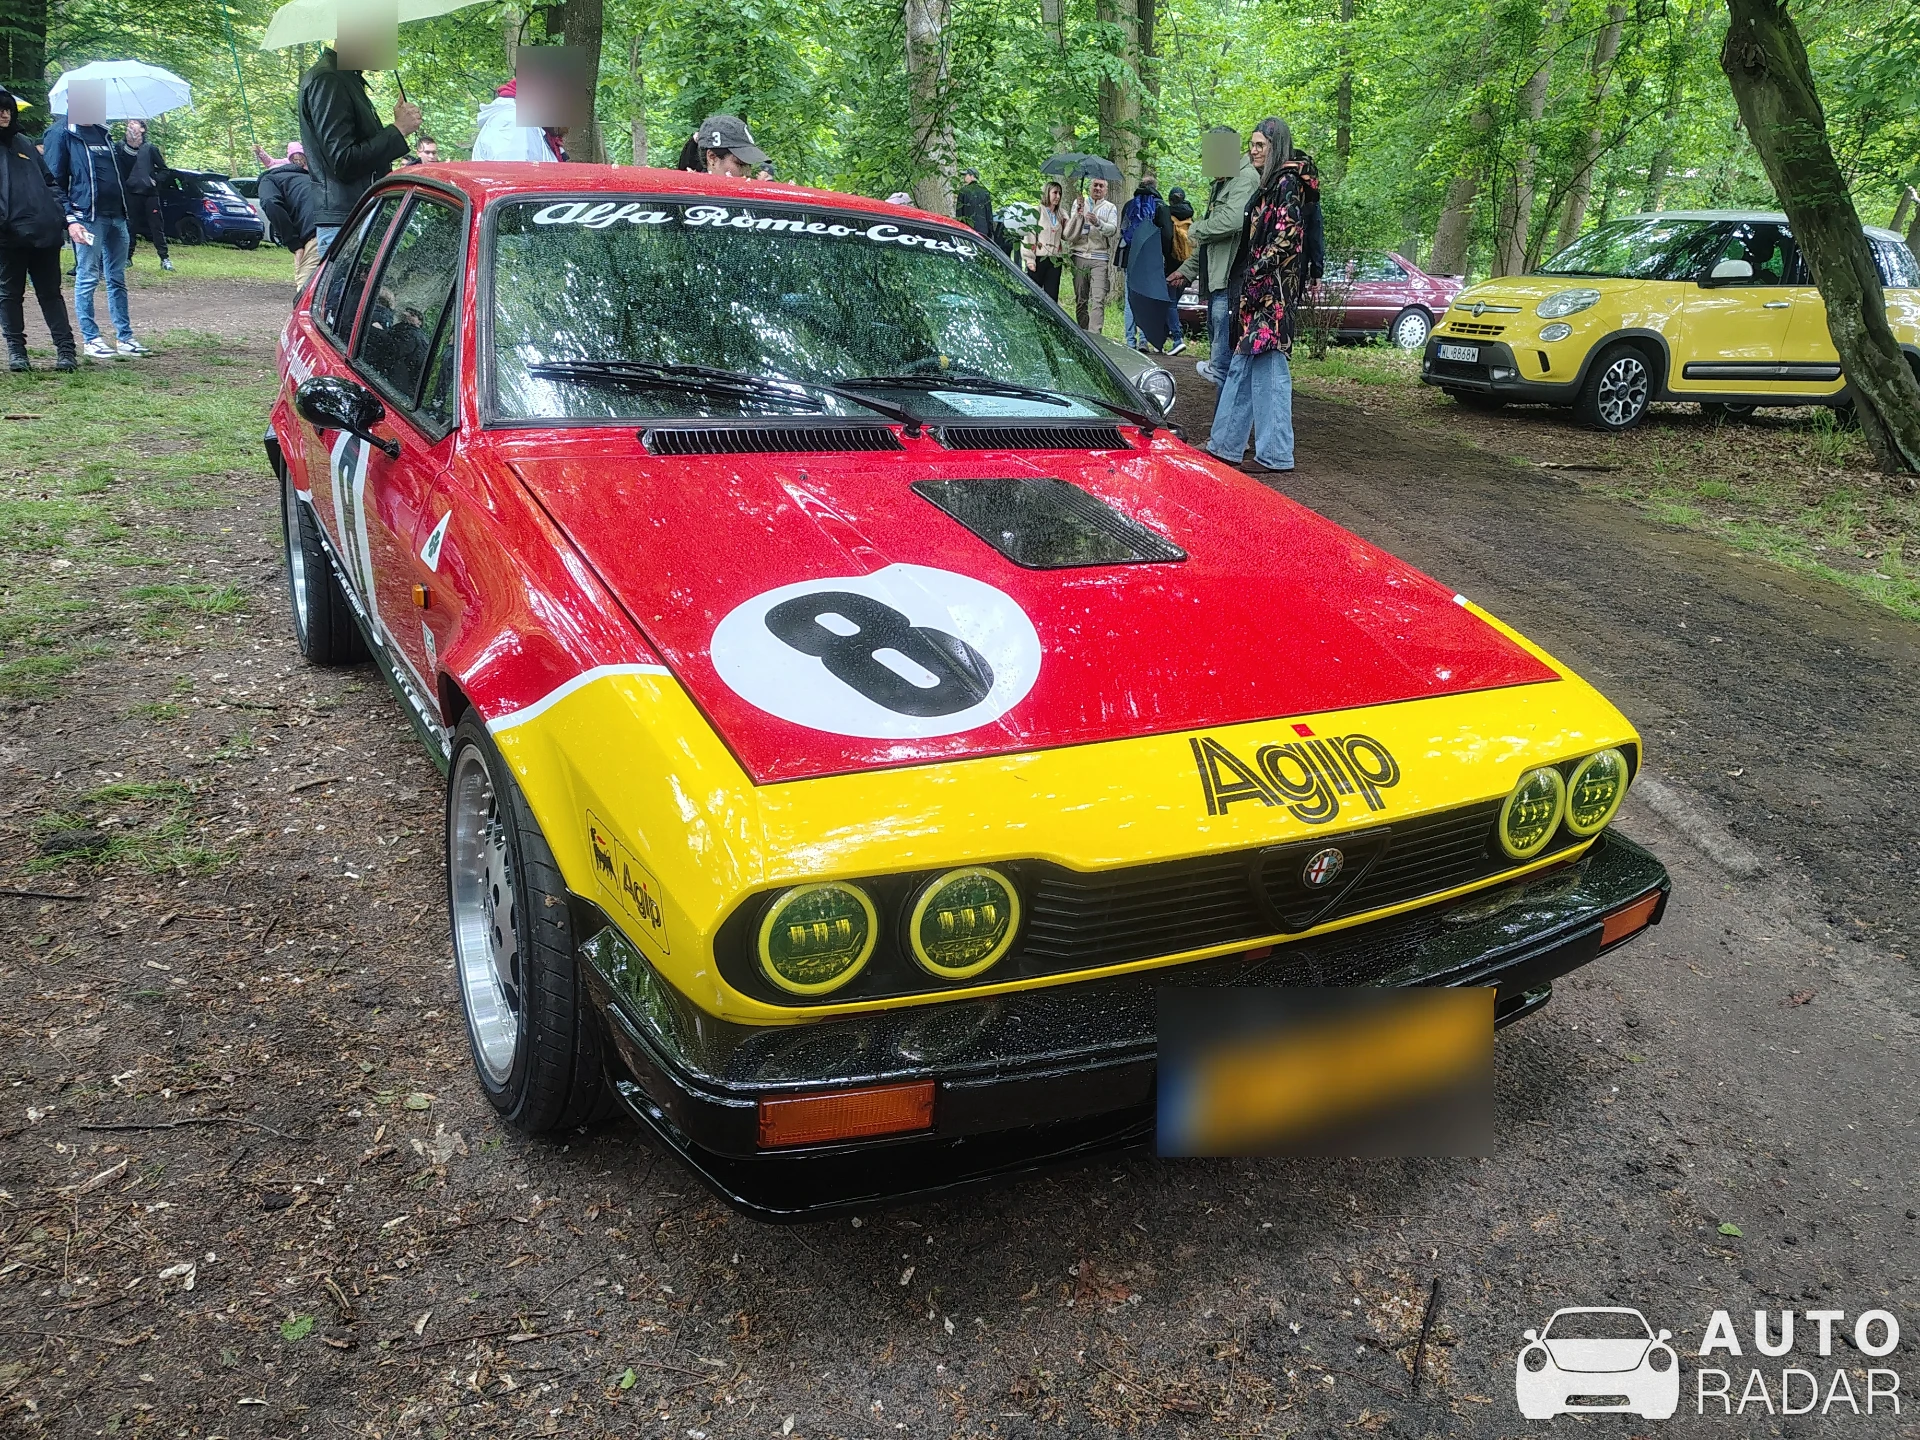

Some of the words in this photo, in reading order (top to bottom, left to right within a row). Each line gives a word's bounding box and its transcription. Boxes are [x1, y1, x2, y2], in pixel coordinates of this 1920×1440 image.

[712, 131, 722, 147] 3
[532, 202, 674, 229] Alfa
[764, 591, 995, 718] 8
[1188, 723, 1401, 825] Agip
[623, 861, 662, 931] Agip
